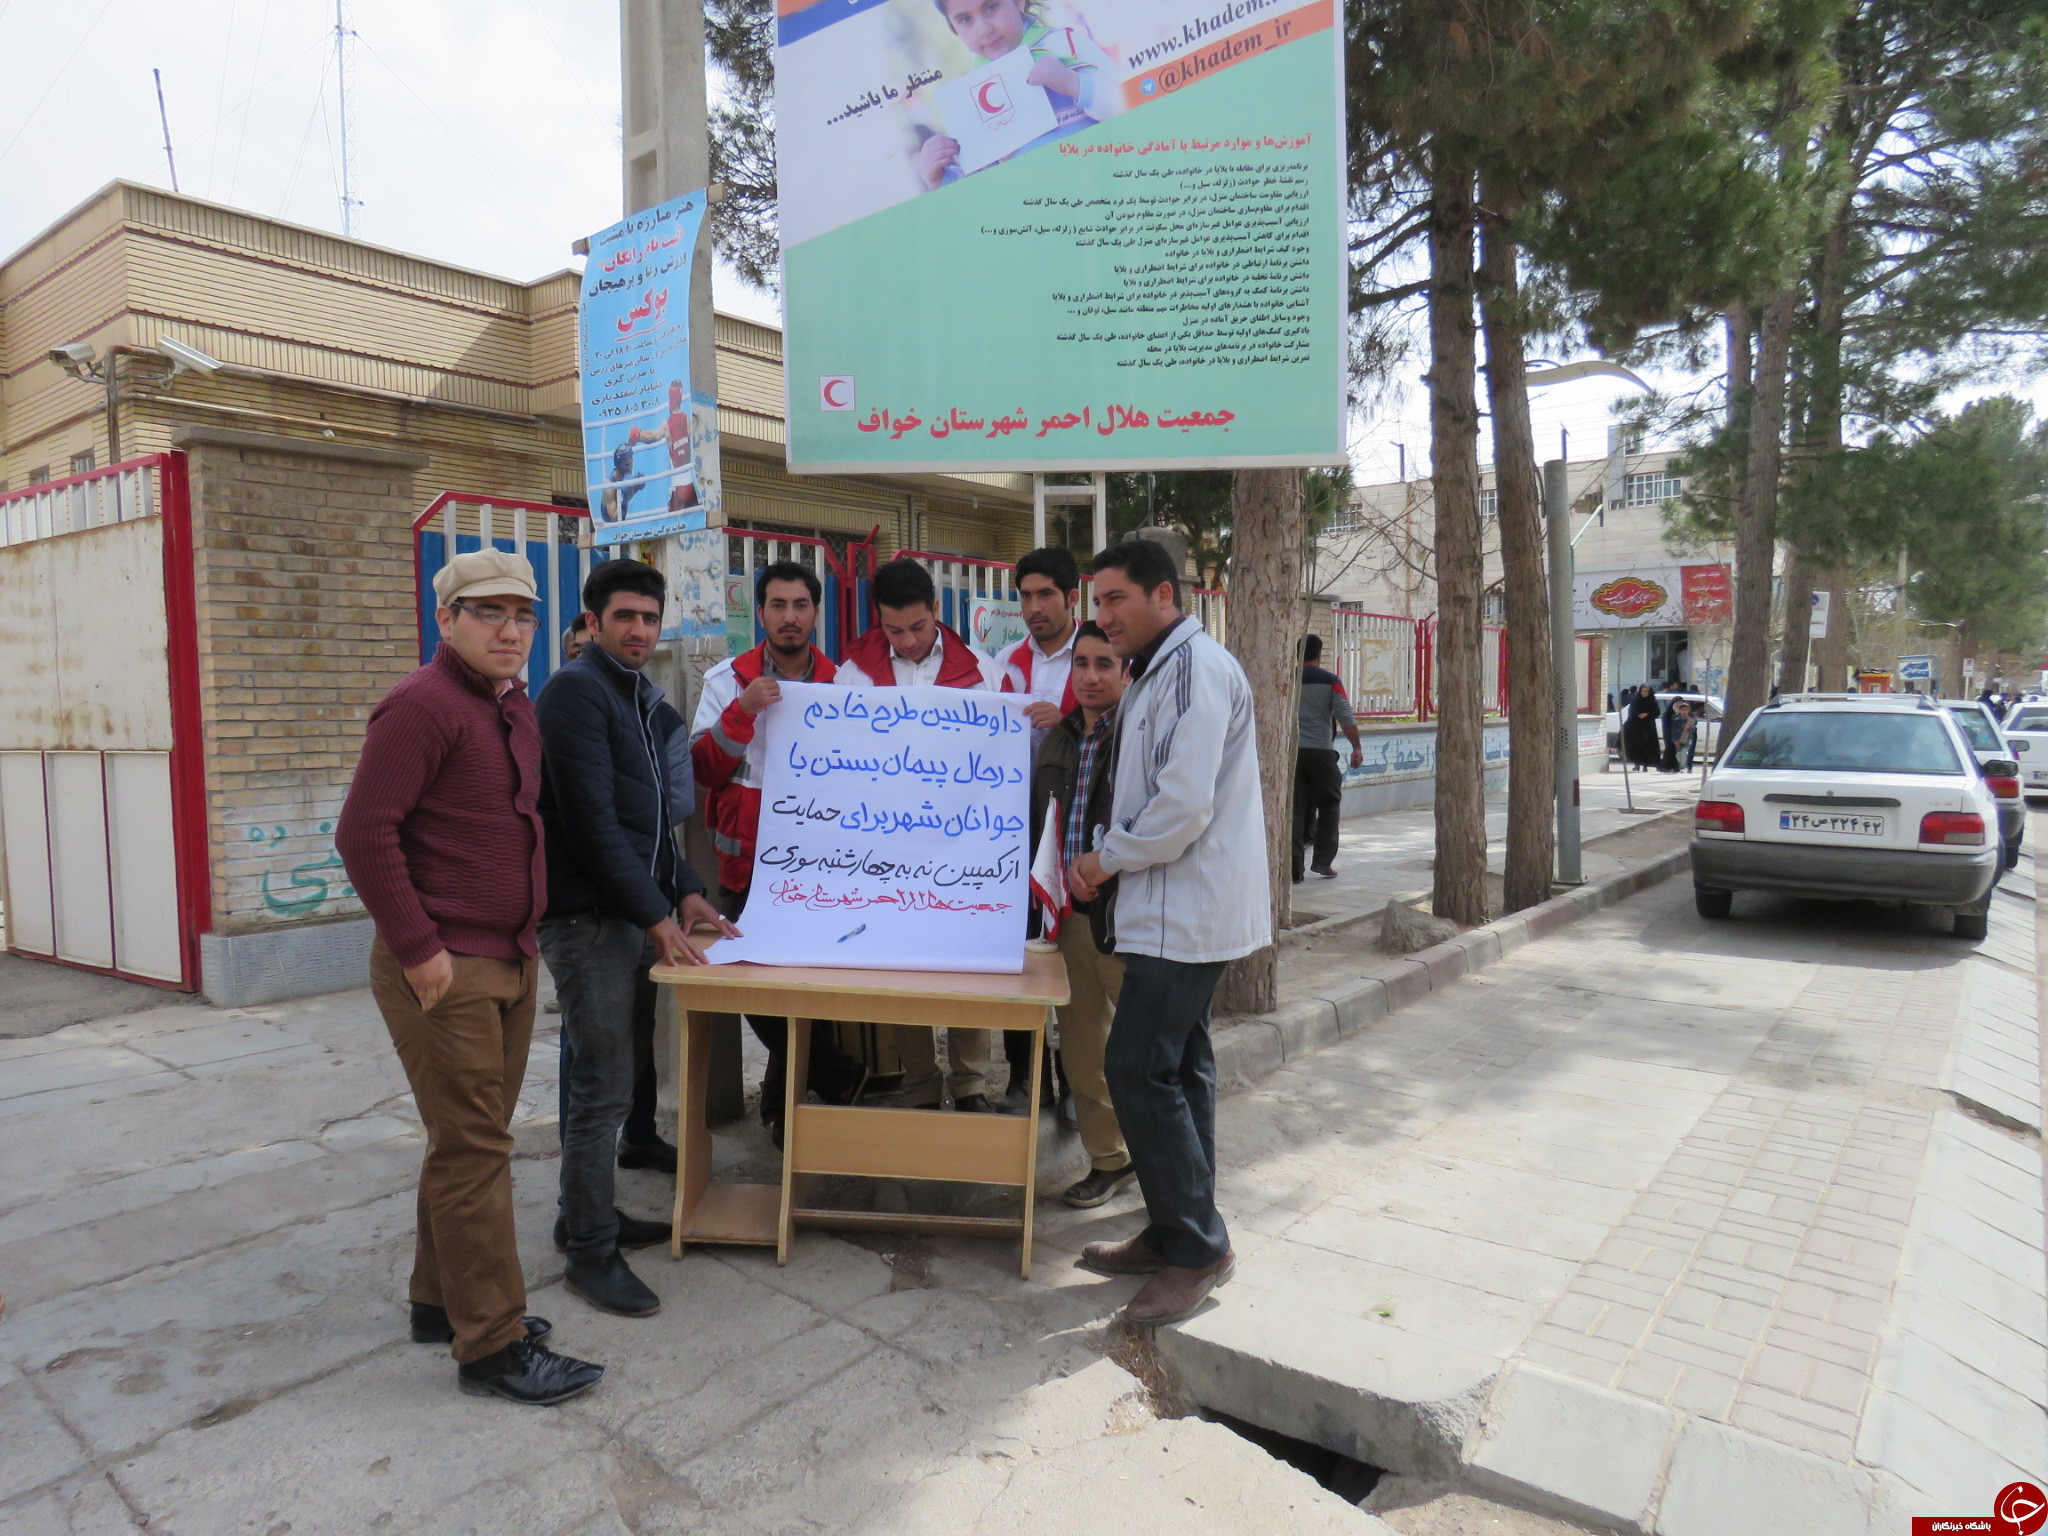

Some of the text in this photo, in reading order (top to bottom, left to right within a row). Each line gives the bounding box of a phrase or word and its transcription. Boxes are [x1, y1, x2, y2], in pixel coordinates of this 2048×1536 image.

[1127, 0, 1277, 69] www.khadem.
[1159, 19, 1292, 93] @khadem_ir
[905, 69, 943, 99] منتظر
[881, 85, 899, 100] ما
[1059, 143, 1079, 155] بلایا
[1083, 144, 1095, 158] در
[1097, 143, 1134, 156] خانواده
[1138, 140, 1175, 155] آمادگی
[1191, 139, 1220, 152] مرتبط
[1224, 137, 1252, 150] موارد
[1255, 163, 1271, 173] برای
[676, 201, 694, 220] هنر
[637, 208, 671, 233] مبارزه
[627, 221, 634, 237] با
[646, 237, 659, 252] نام
[1221, 246, 1253, 257] اضطراری
[1254, 245, 1275, 255] شرایط
[1291, 246, 1310, 255] وجود
[1165, 249, 1190, 260] خانواده
[1201, 248, 1215, 258] بلایا
[660, 252, 687, 274] ورزش
[637, 273, 643, 286] و
[617, 287, 669, 333] بوکس
[1182, 316, 1199, 327] منزل
[1210, 313, 1229, 323] آماده
[1292, 314, 1310, 323] وجود
[1173, 344, 1187, 354] بلایا
[1187, 344, 1213, 353] مدیریت
[1257, 340, 1282, 351] خانواده
[1283, 340, 1310, 351] مشارکت
[1217, 355, 1231, 365] بلایا
[1237, 354, 1268, 365] اضطراری
[1269, 354, 1290, 364] شرایط
[857, 405, 1236, 439] جمعیت هلال احمر شهرستان خواف
[804, 692, 1023, 737] داوطلبین طرح خادم
[789, 741, 808, 778] با
[810, 749, 880, 782] بستن
[882, 745, 948, 789] پیمان
[772, 795, 1024, 841] جوانان شهر برای حمایت
[759, 845, 819, 874] سوری
[895, 863, 911, 880] به
[914, 860, 933, 879] نه
[934, 846, 1020, 890] کمپین
[1000, 859, 1020, 884] از
[947, 898, 1013, 915] جمعیت
